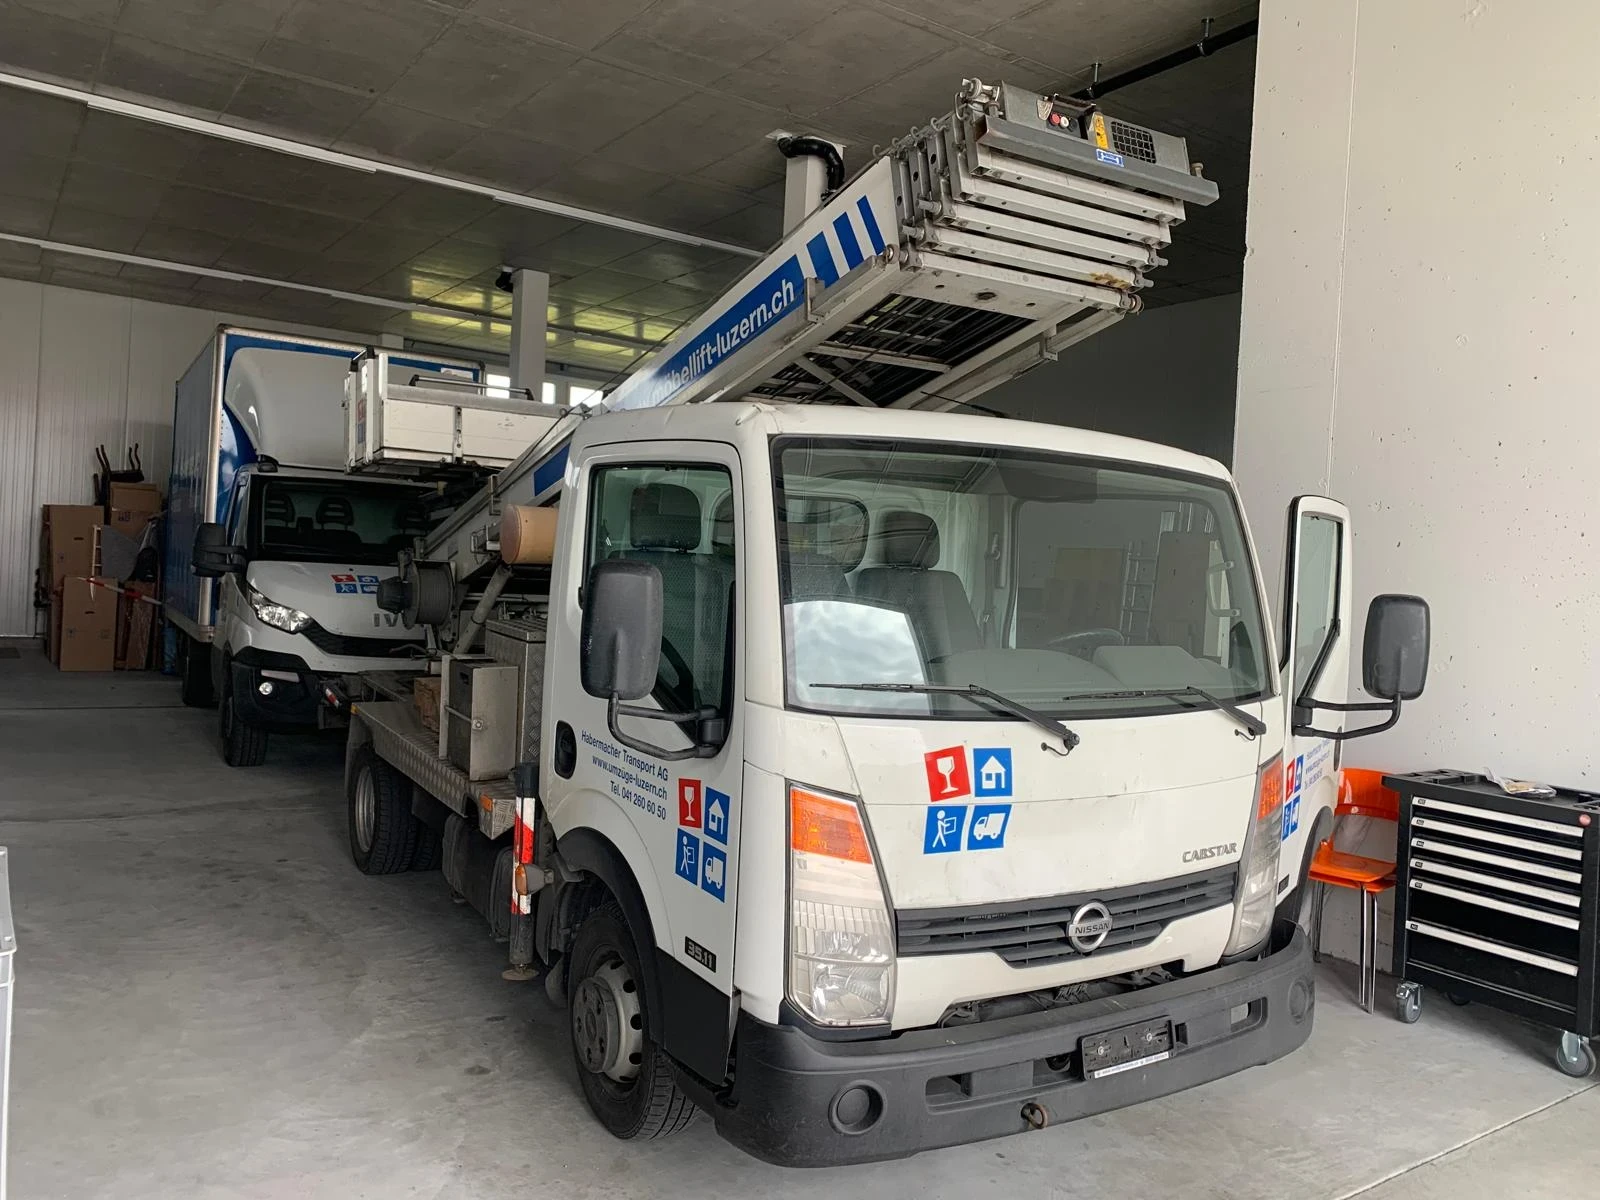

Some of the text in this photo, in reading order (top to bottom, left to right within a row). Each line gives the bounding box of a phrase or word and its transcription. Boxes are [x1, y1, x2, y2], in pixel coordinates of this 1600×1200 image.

[581, 730, 669, 781] Habermacher Transport AG
[592, 755, 668, 800] www.umzüge-luzern.ch
[610, 780, 667, 820] Tel. 041 260 60 50
[1182, 842, 1237, 863] CABSTAR
[1075, 922, 1110, 935] NISSAN
[687, 941, 713, 969] 35.11
